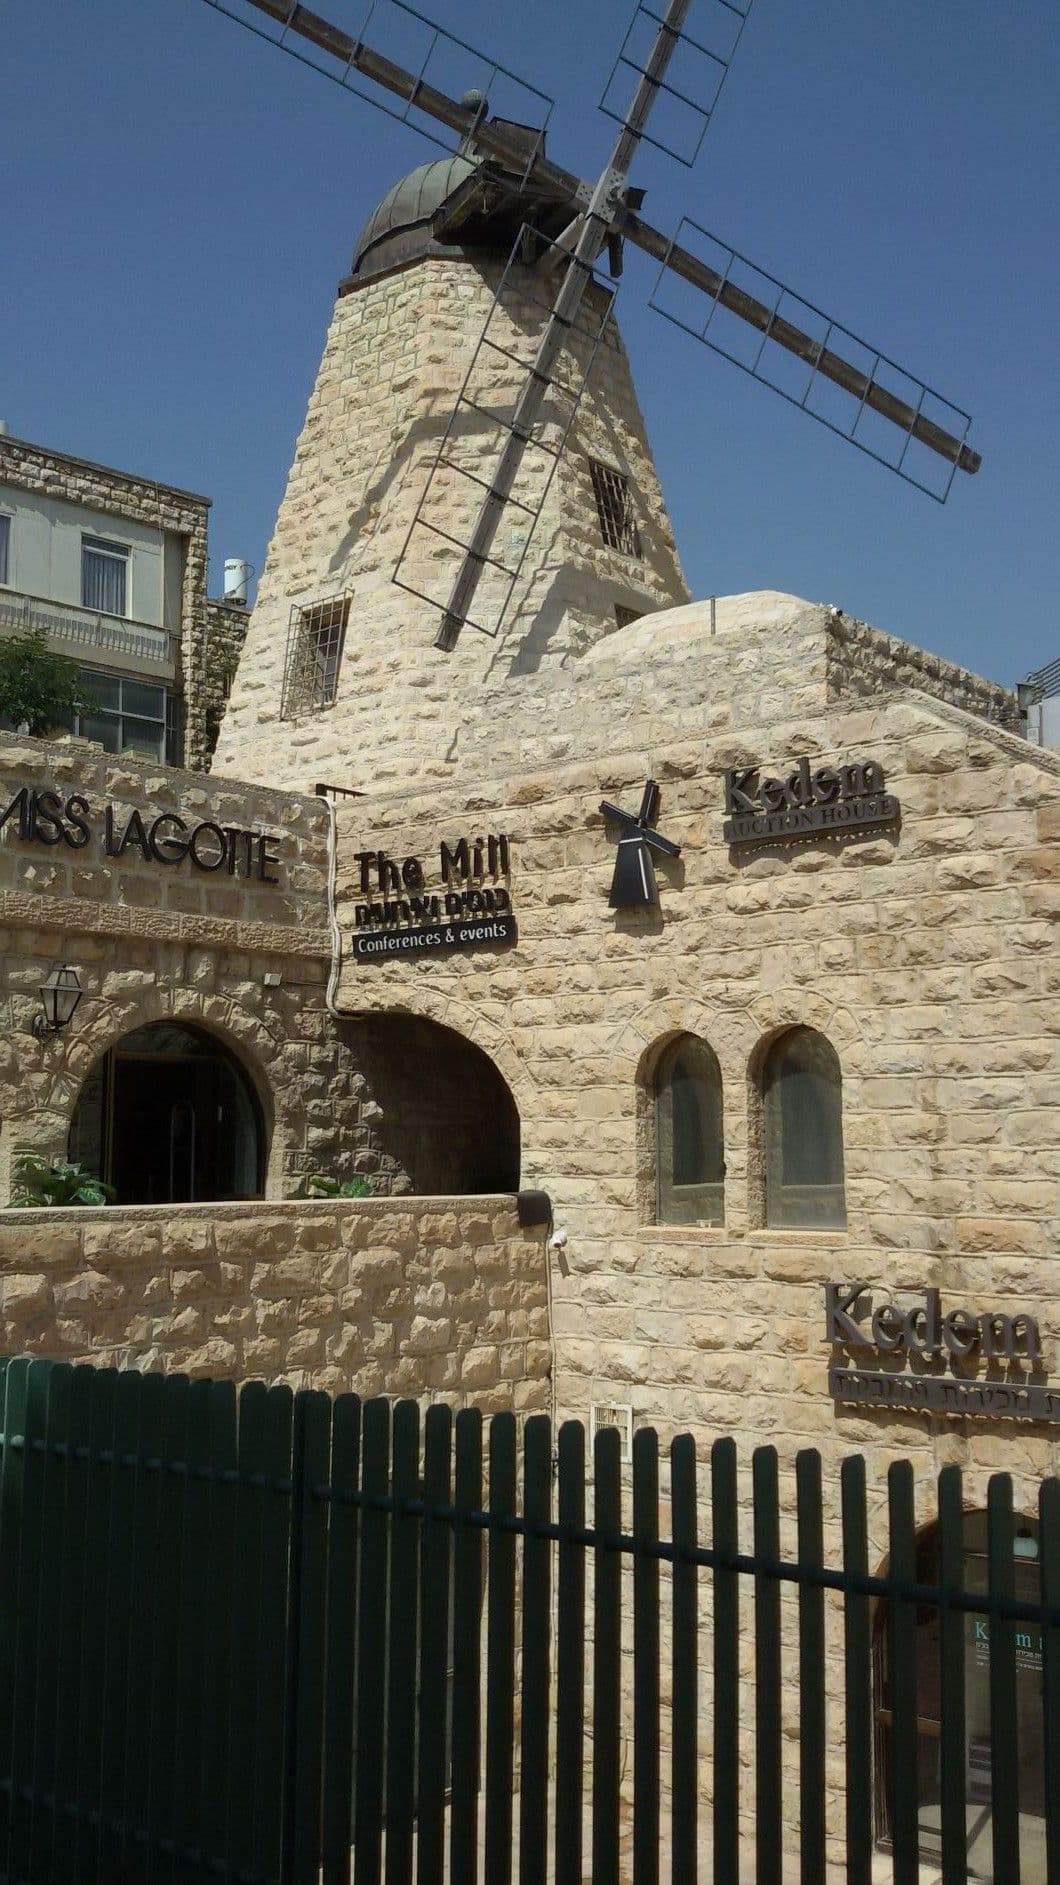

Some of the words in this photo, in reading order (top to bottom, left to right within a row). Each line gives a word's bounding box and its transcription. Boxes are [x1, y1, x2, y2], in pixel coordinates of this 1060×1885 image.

[722, 756, 888, 815] Kedem
[105, 804, 281, 883] LAGOTTE
[726, 812, 814, 839] AUCTION
[821, 799, 893, 824] HOUSE
[353, 850, 426, 893] The
[440, 834, 511, 883] Mill
[358, 931, 442, 954] Conferences
[445, 928, 455, 944] &
[460, 923, 508, 941] events
[819, 1282, 1047, 1360] Kedem
